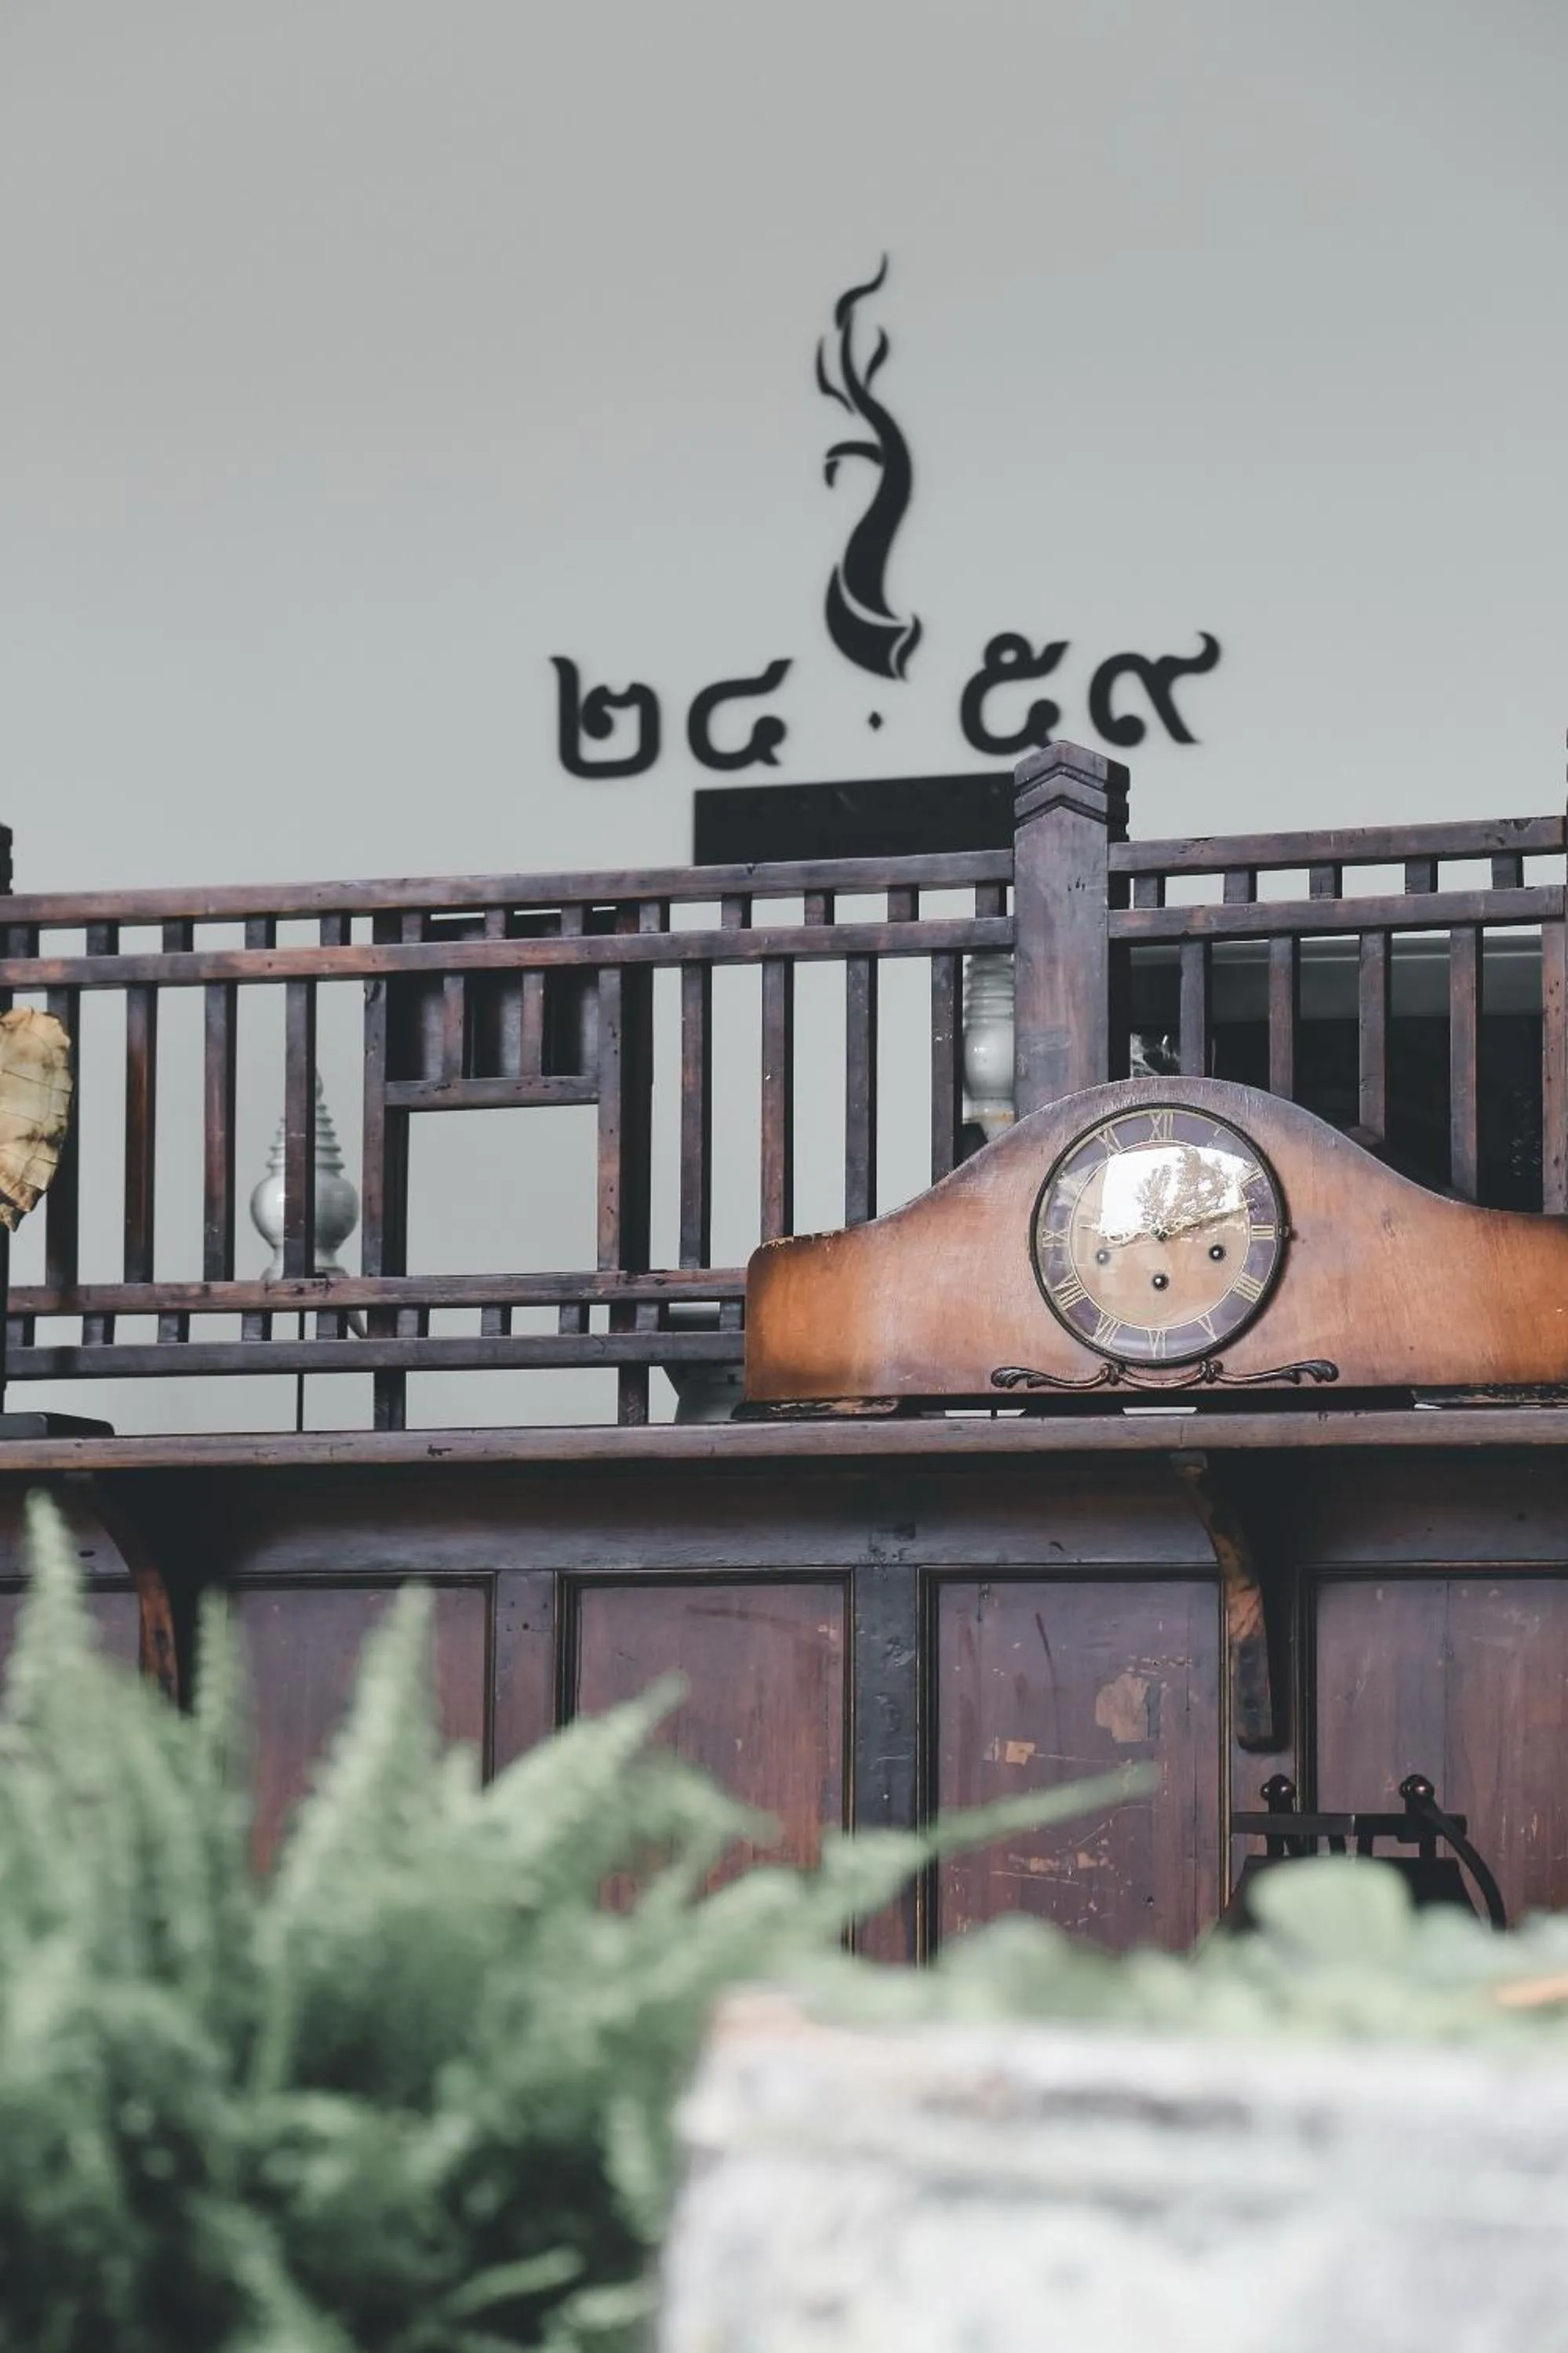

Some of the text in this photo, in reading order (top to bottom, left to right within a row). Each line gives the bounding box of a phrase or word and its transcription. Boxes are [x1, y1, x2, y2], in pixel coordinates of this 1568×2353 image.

[1148, 1112, 1175, 1141] XII
[1097, 1126, 1123, 1158] XI
[1250, 1225, 1275, 1240] III
[1196, 1313, 1218, 1341] V
[1146, 1328, 1167, 1359] VI
